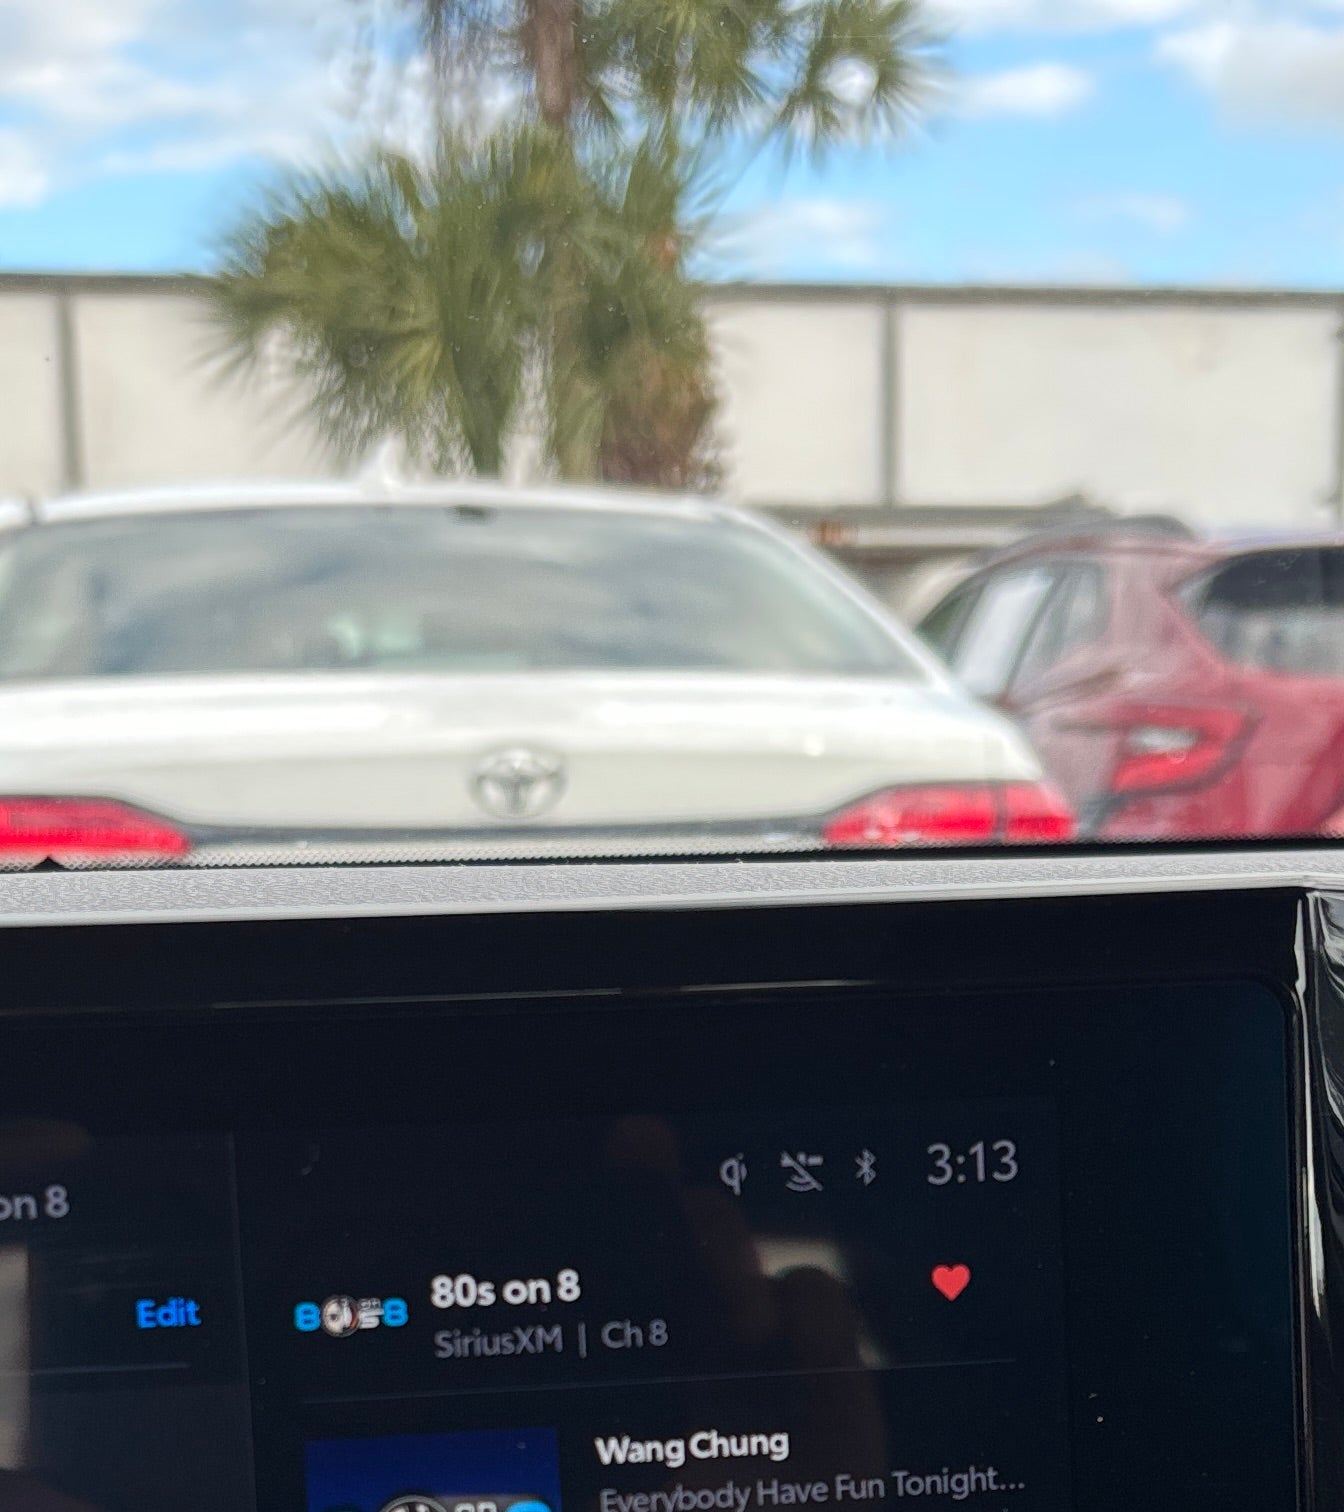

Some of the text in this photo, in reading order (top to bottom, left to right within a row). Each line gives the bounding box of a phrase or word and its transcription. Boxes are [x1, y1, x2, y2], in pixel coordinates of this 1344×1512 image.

[927, 1139, 1019, 1186] 3:13
[45, 1184, 70, 1219] 8
[431, 1268, 581, 1309] 80s on 8
[135, 1297, 202, 1329] Edit
[434, 1318, 669, 1359] SiriusXM Ch 8
[594, 1429, 790, 1468] Wang Chung
[756, 1478, 829, 1506] Have
[834, 1473, 886, 1501] Fun
